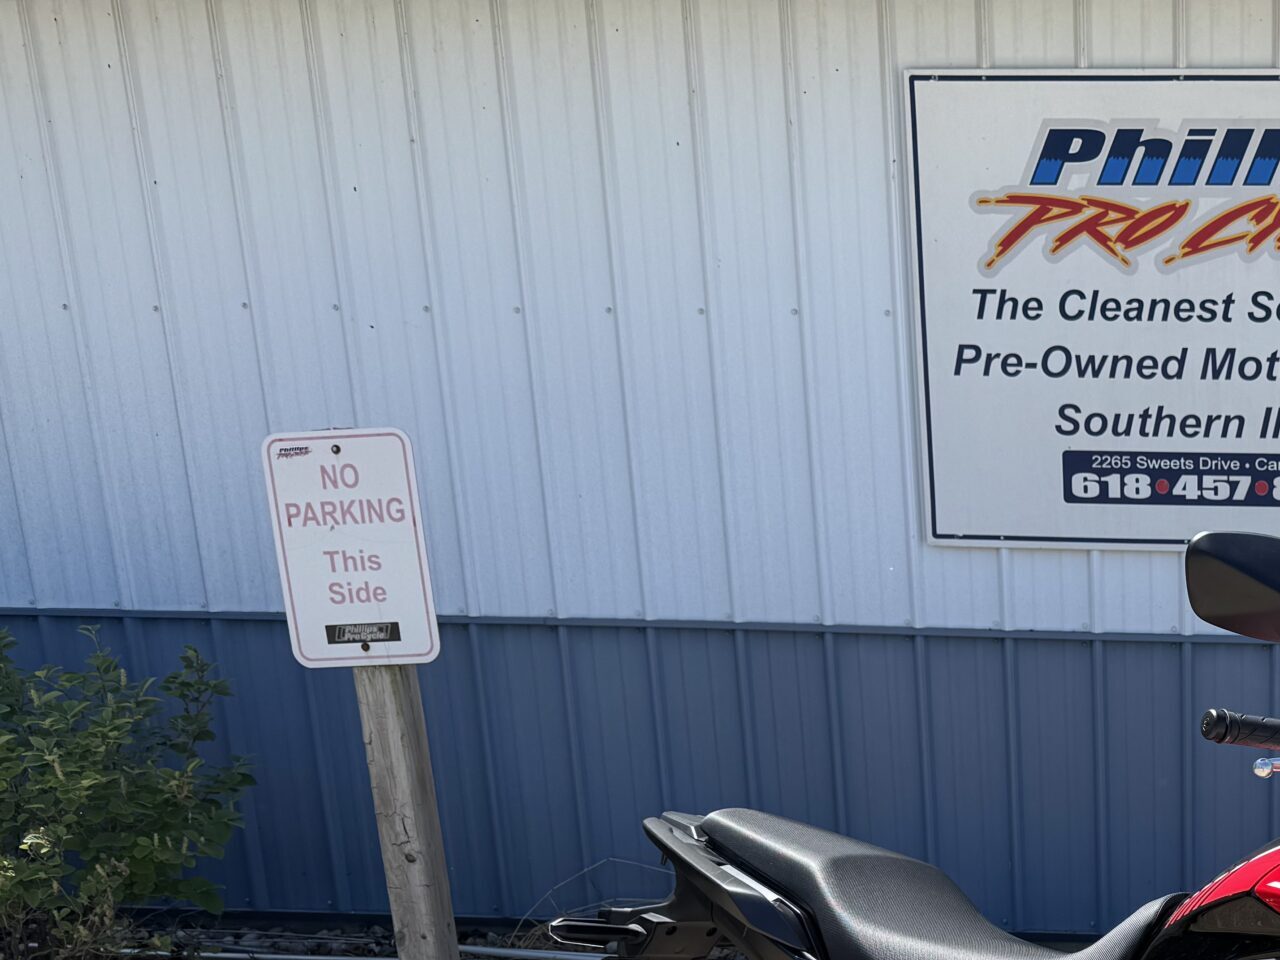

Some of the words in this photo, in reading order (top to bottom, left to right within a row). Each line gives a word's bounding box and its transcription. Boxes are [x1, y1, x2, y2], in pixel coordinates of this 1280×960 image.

[976, 193, 1191, 267] PRO
[971, 288, 1044, 322] The
[1057, 289, 1235, 324] Cleanest
[953, 344, 1188, 381] Pre-Owned
[1055, 404, 1246, 439] Southern
[319, 463, 360, 490] NO
[1091, 455, 1132, 469] 2265
[1136, 456, 1194, 470] Sweets
[1199, 457, 1240, 470] Drive
[284, 497, 406, 528] PARKING
[322, 549, 382, 573] This
[328, 581, 387, 605] Side
